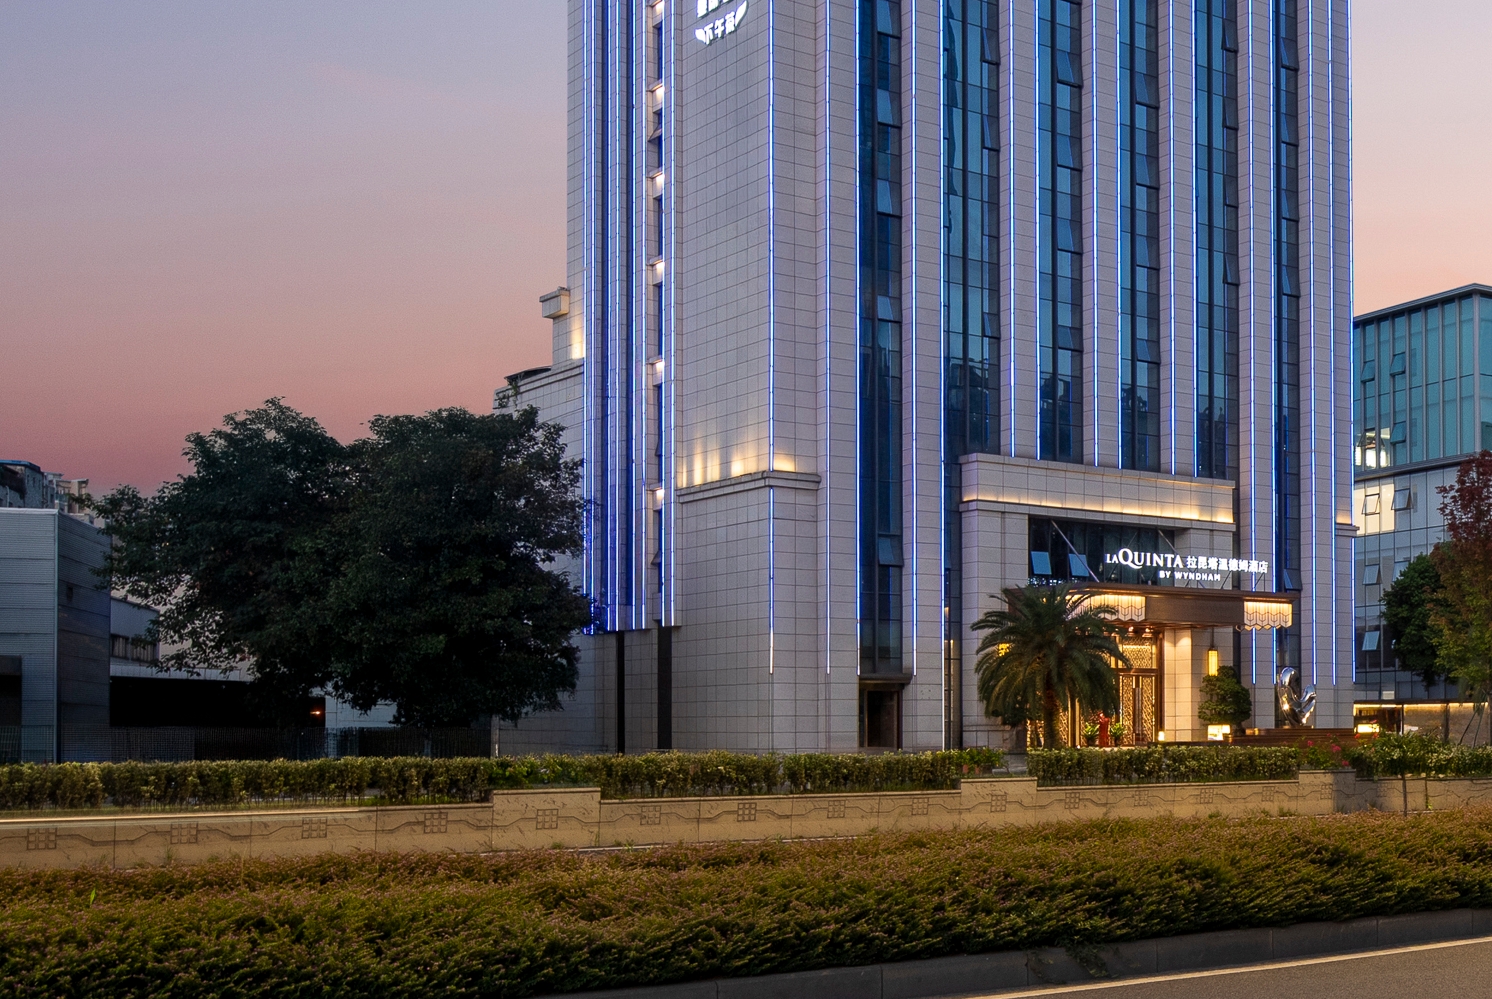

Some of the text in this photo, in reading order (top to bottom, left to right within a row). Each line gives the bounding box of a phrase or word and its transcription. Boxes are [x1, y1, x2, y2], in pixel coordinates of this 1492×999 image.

[1187, 555, 1269, 574] 拉昆塔温德姆酒店
[1159, 570, 1221, 582] BY WYNDHAM
